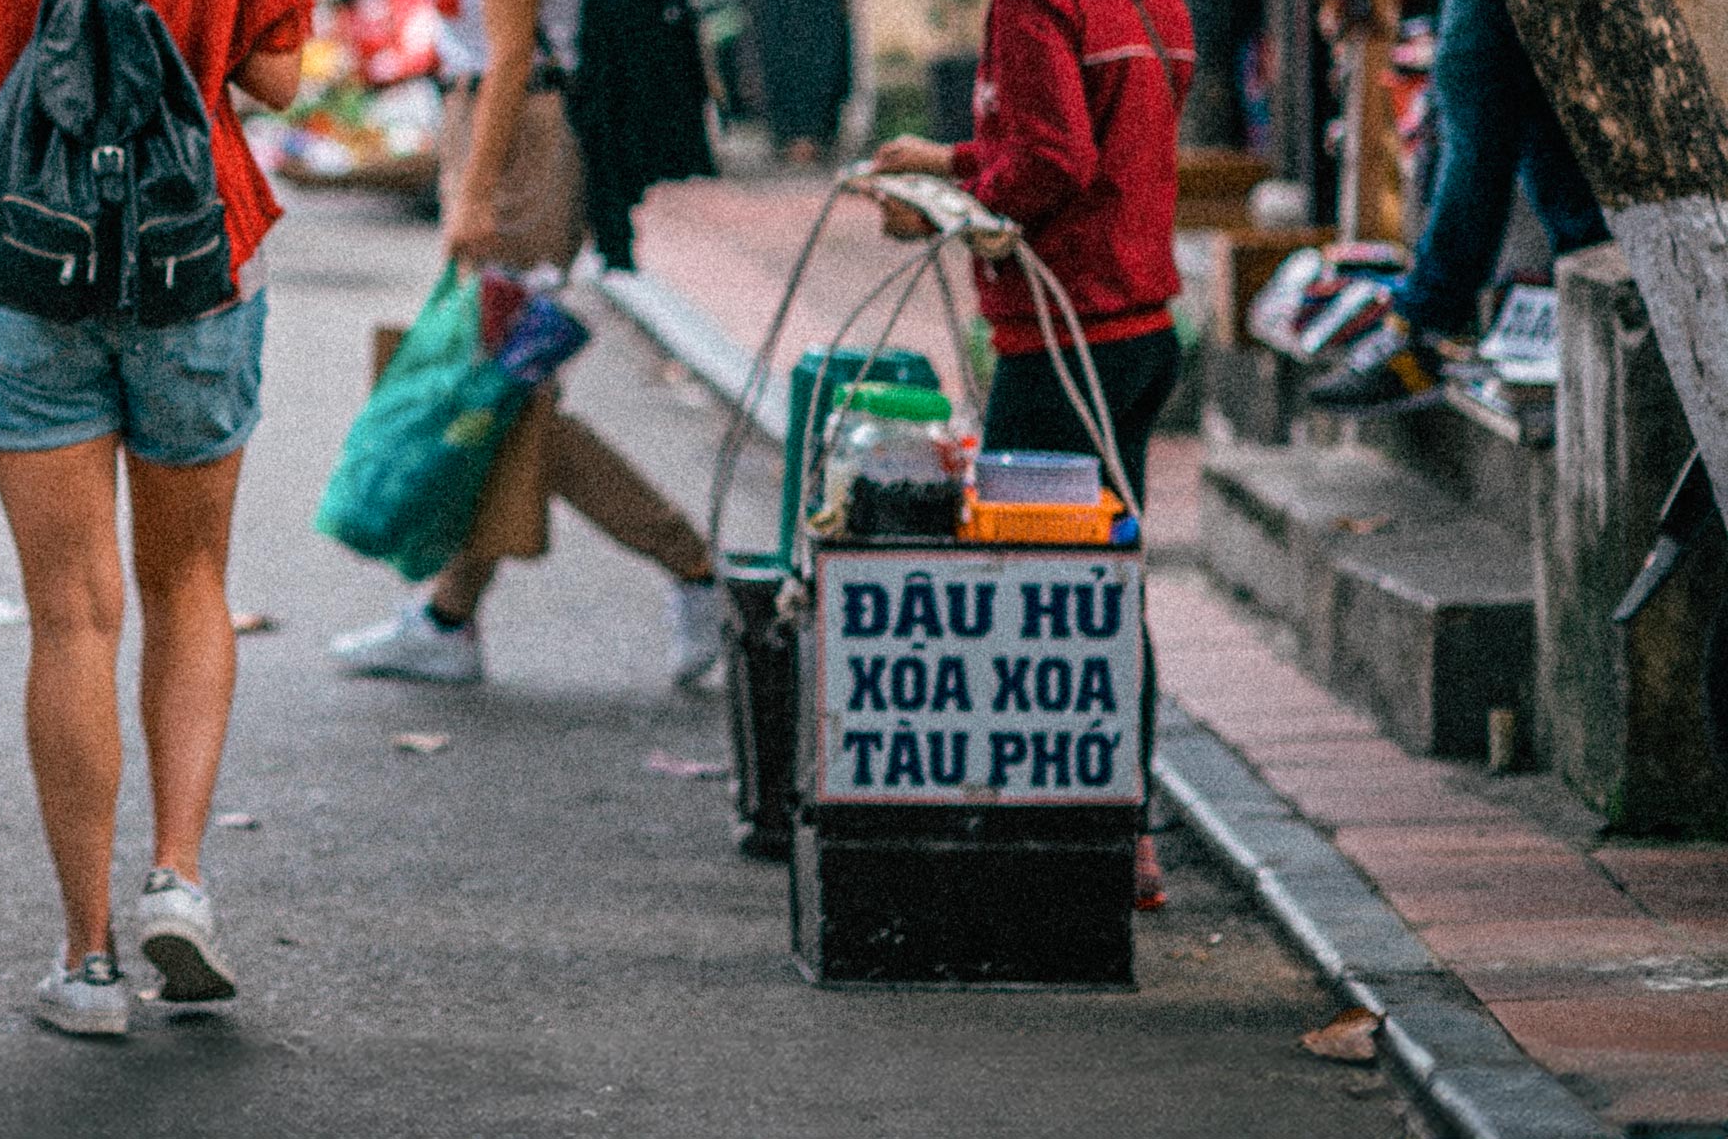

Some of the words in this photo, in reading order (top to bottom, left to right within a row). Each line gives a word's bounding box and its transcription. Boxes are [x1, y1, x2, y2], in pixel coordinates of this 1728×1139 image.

[842, 571, 996, 650] ĐẬU
[1020, 566, 1124, 638] HỦ
[847, 656, 972, 712] XOA
[992, 656, 1117, 712] XOA
[842, 719, 969, 787] TÀU
[988, 719, 1121, 787] PHỚ
